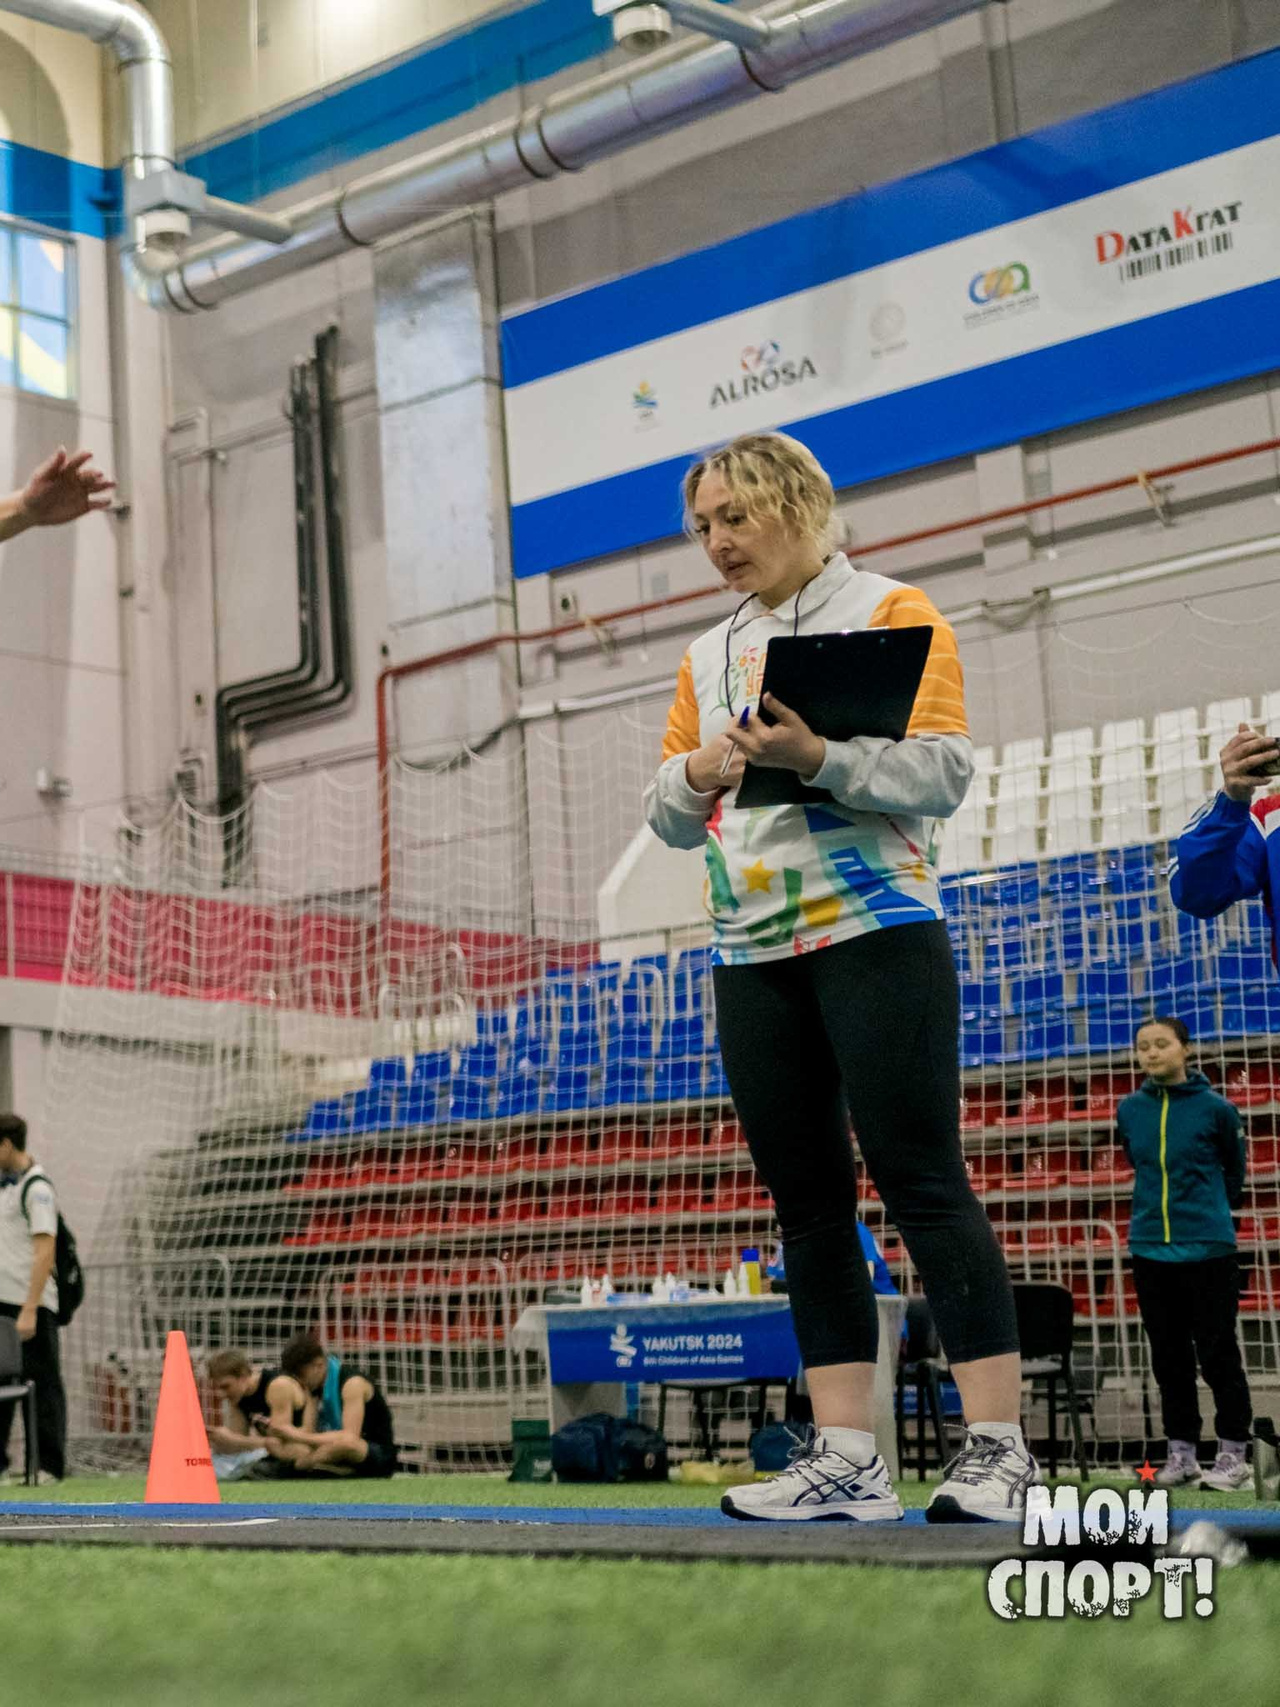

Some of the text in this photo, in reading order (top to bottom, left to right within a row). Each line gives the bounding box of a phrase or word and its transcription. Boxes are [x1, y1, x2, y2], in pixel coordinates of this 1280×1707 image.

[709, 355, 819, 410] ALROSA
[642, 1333, 743, 1352] YAKUTSK 2024
[699, 1355, 716, 1365] Asia
[717, 1354, 744, 1364] Games
